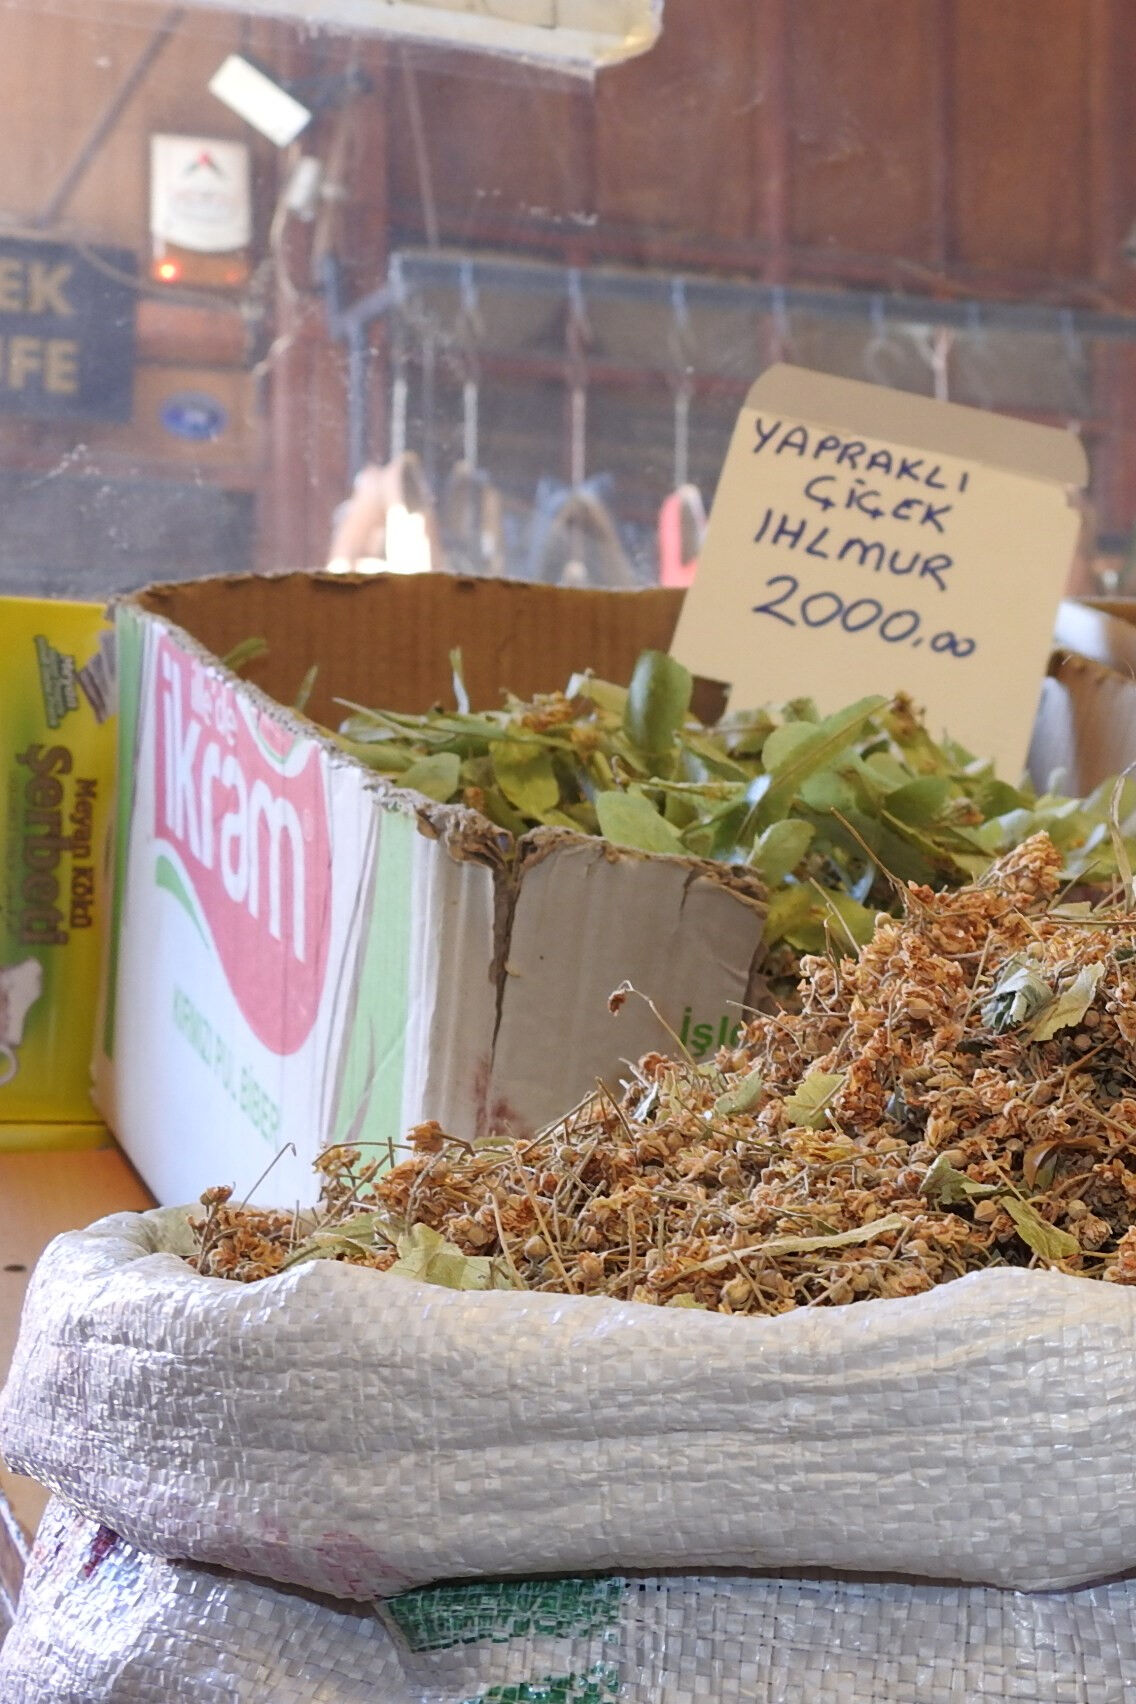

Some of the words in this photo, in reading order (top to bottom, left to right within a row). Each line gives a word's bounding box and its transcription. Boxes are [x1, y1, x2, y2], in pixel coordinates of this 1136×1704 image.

[752, 417, 970, 494] YAPRAKLI
[803, 474, 953, 533] ÇİÇEK
[753, 508, 954, 592] IHLMUR
